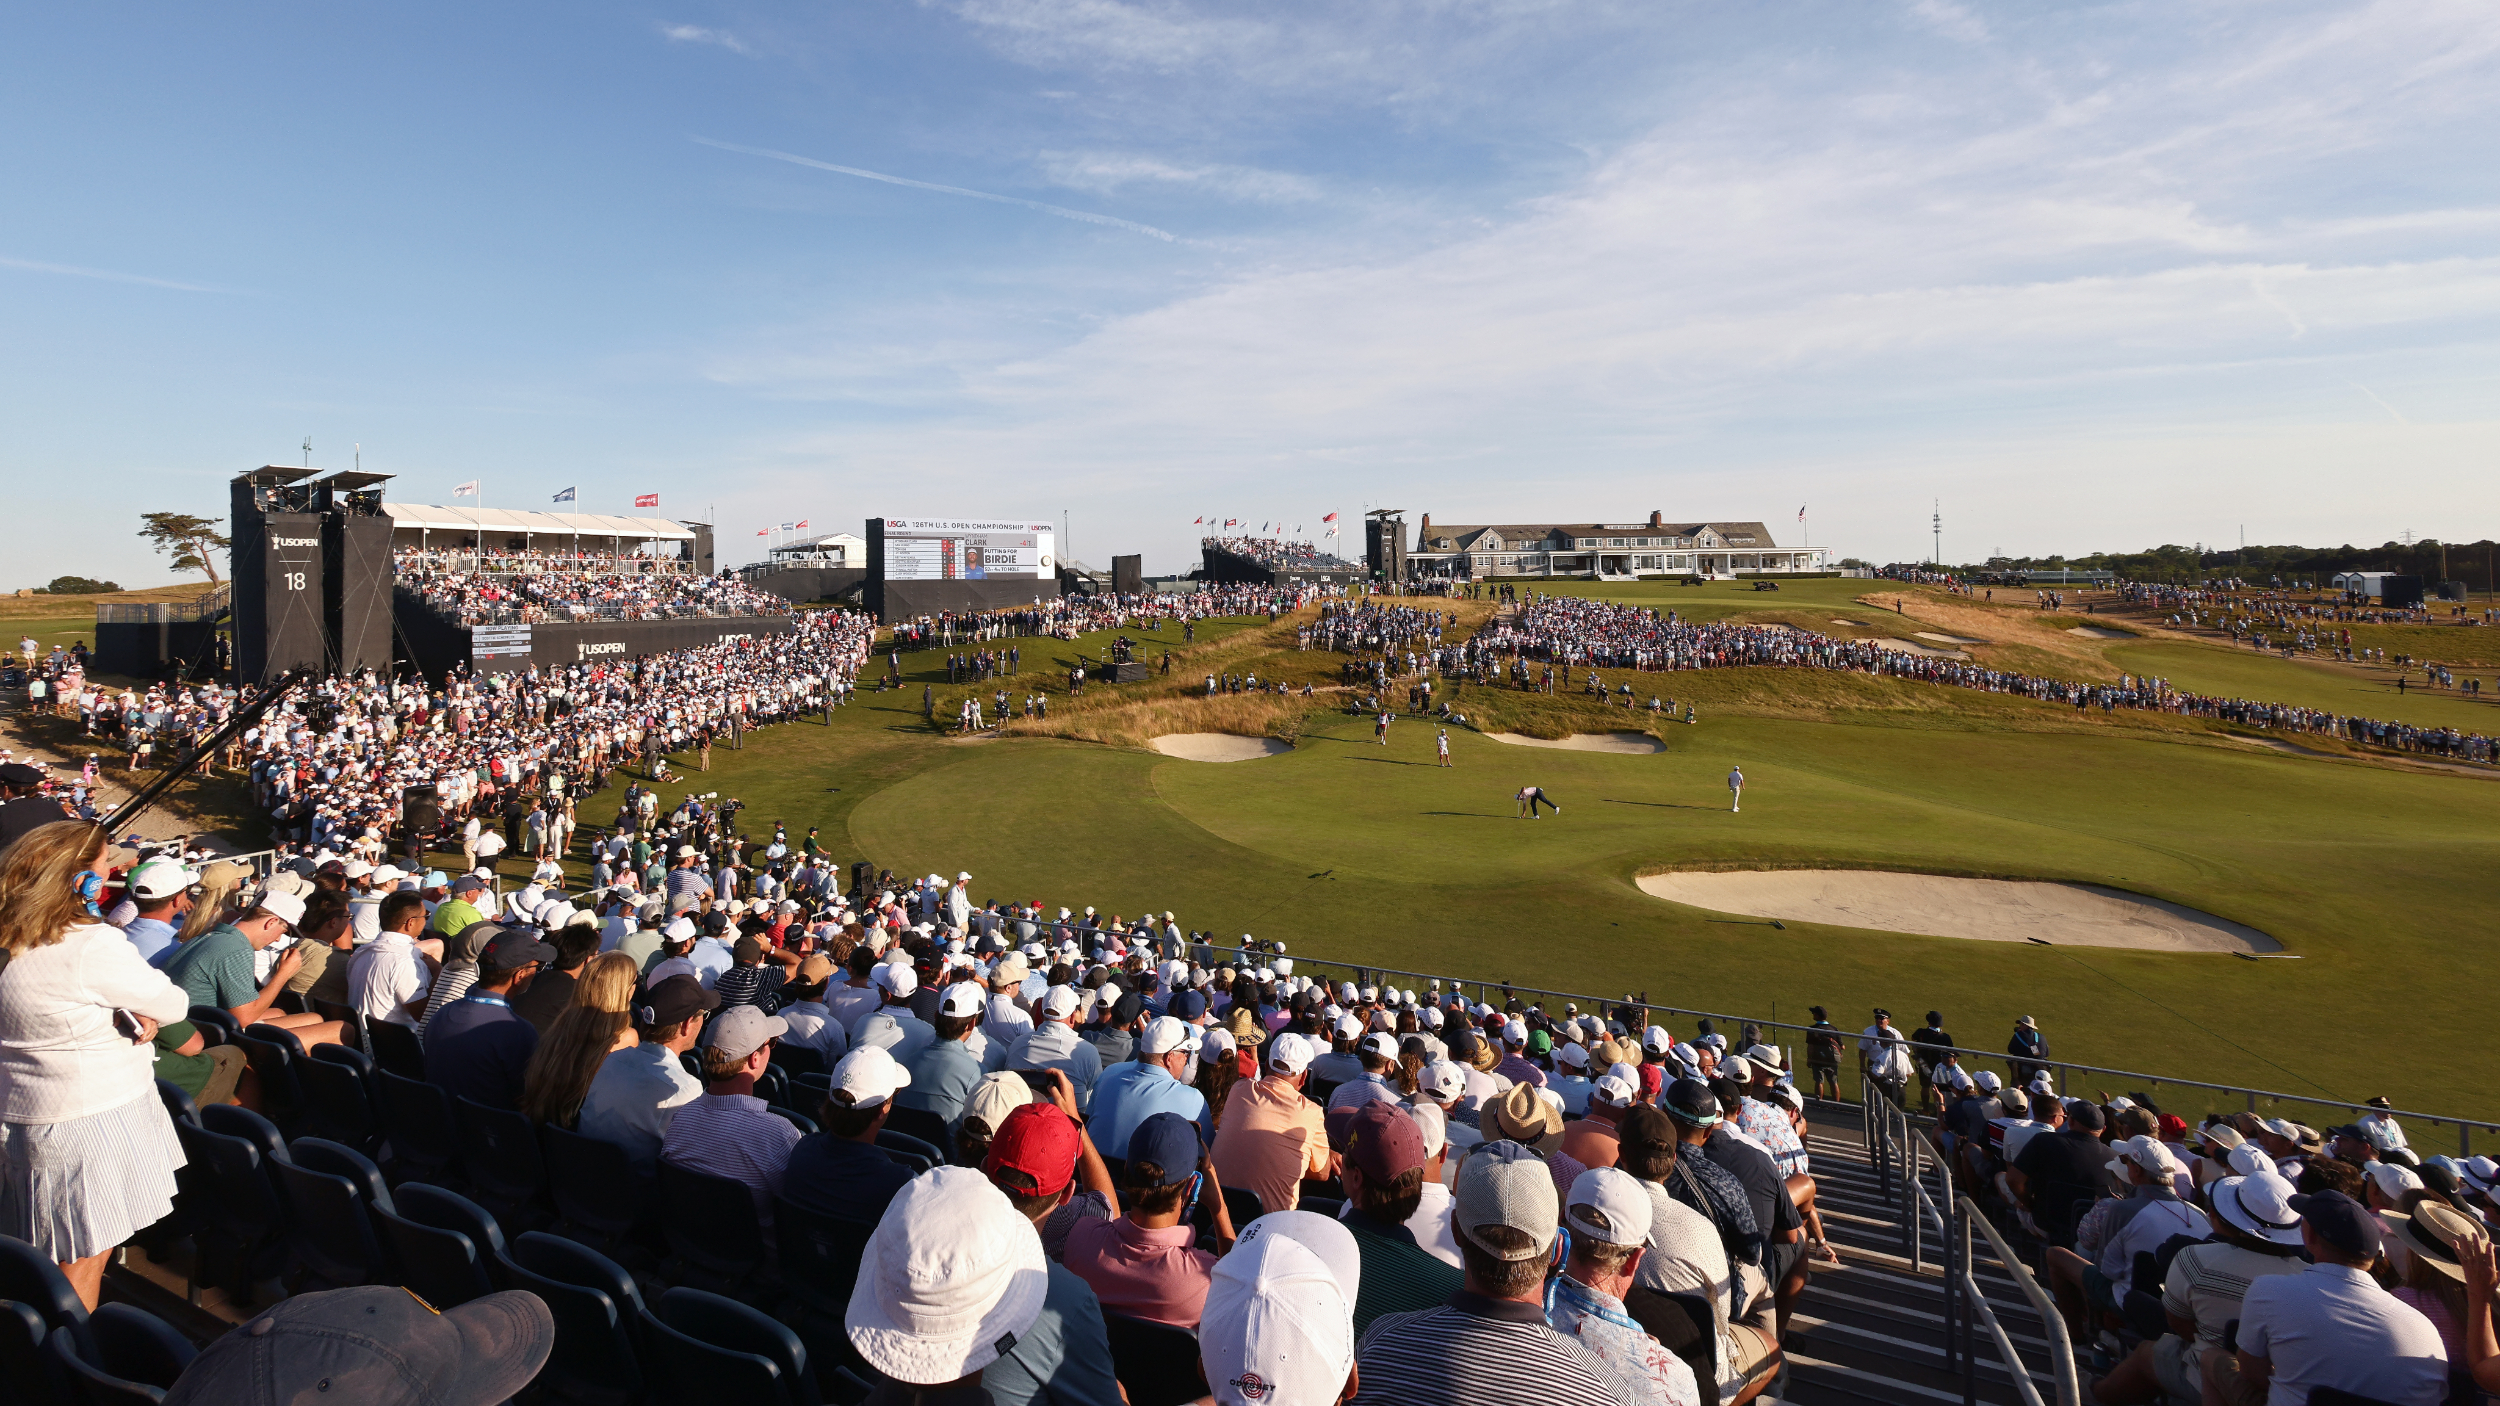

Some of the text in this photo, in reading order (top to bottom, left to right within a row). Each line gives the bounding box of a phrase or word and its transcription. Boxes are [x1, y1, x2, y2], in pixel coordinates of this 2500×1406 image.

[886, 520, 907, 528] USGA
[971, 523, 1024, 531] CHAMPIONSHIP
[280, 537, 319, 547] USOPEN
[984, 555, 1017, 563] BIRDIE
[284, 572, 306, 591] 18
[585, 642, 626, 655] USOPEN
[1233, 1034, 1263, 1044] PEN
[1229, 1379, 1277, 1392] ODYSSEY
